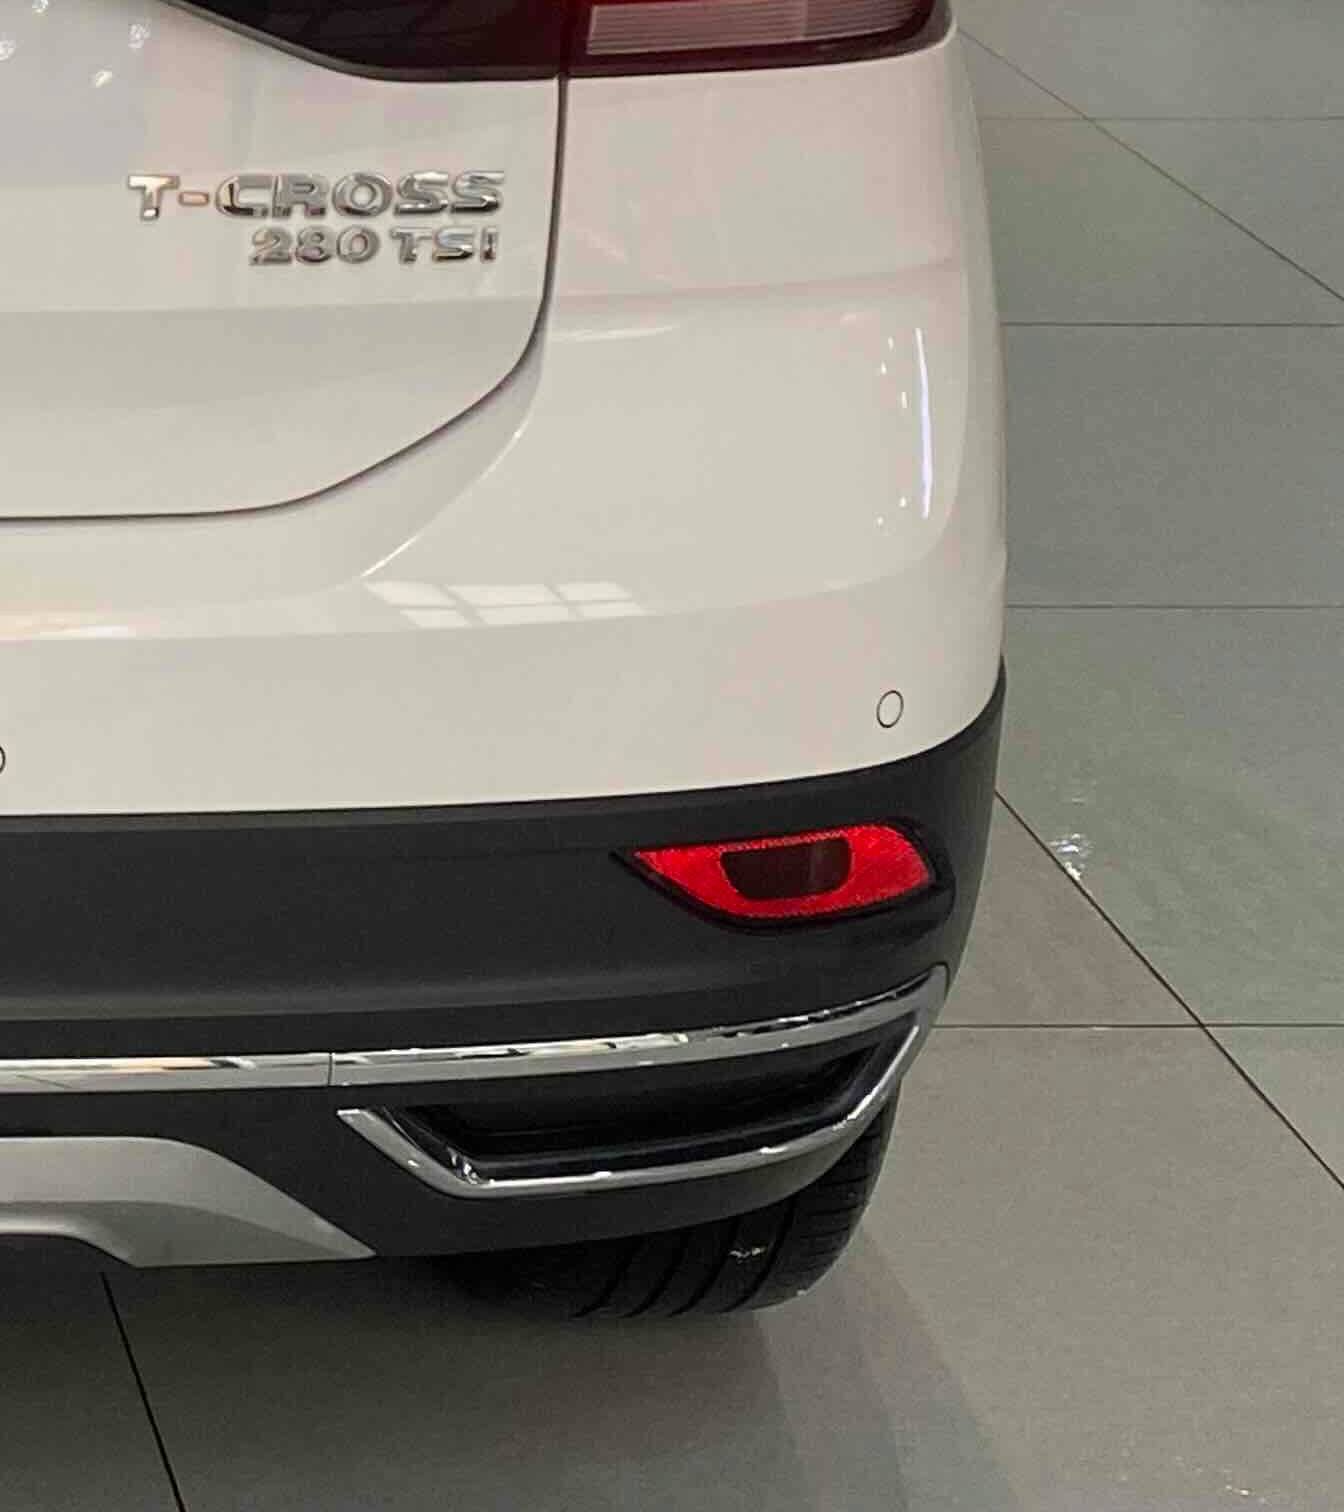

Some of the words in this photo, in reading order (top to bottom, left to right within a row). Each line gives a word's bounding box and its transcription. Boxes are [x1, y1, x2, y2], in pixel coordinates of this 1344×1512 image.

[126, 169, 505, 222] T-CROSS
[249, 224, 382, 267] 280
[390, 225, 500, 265] TSI
